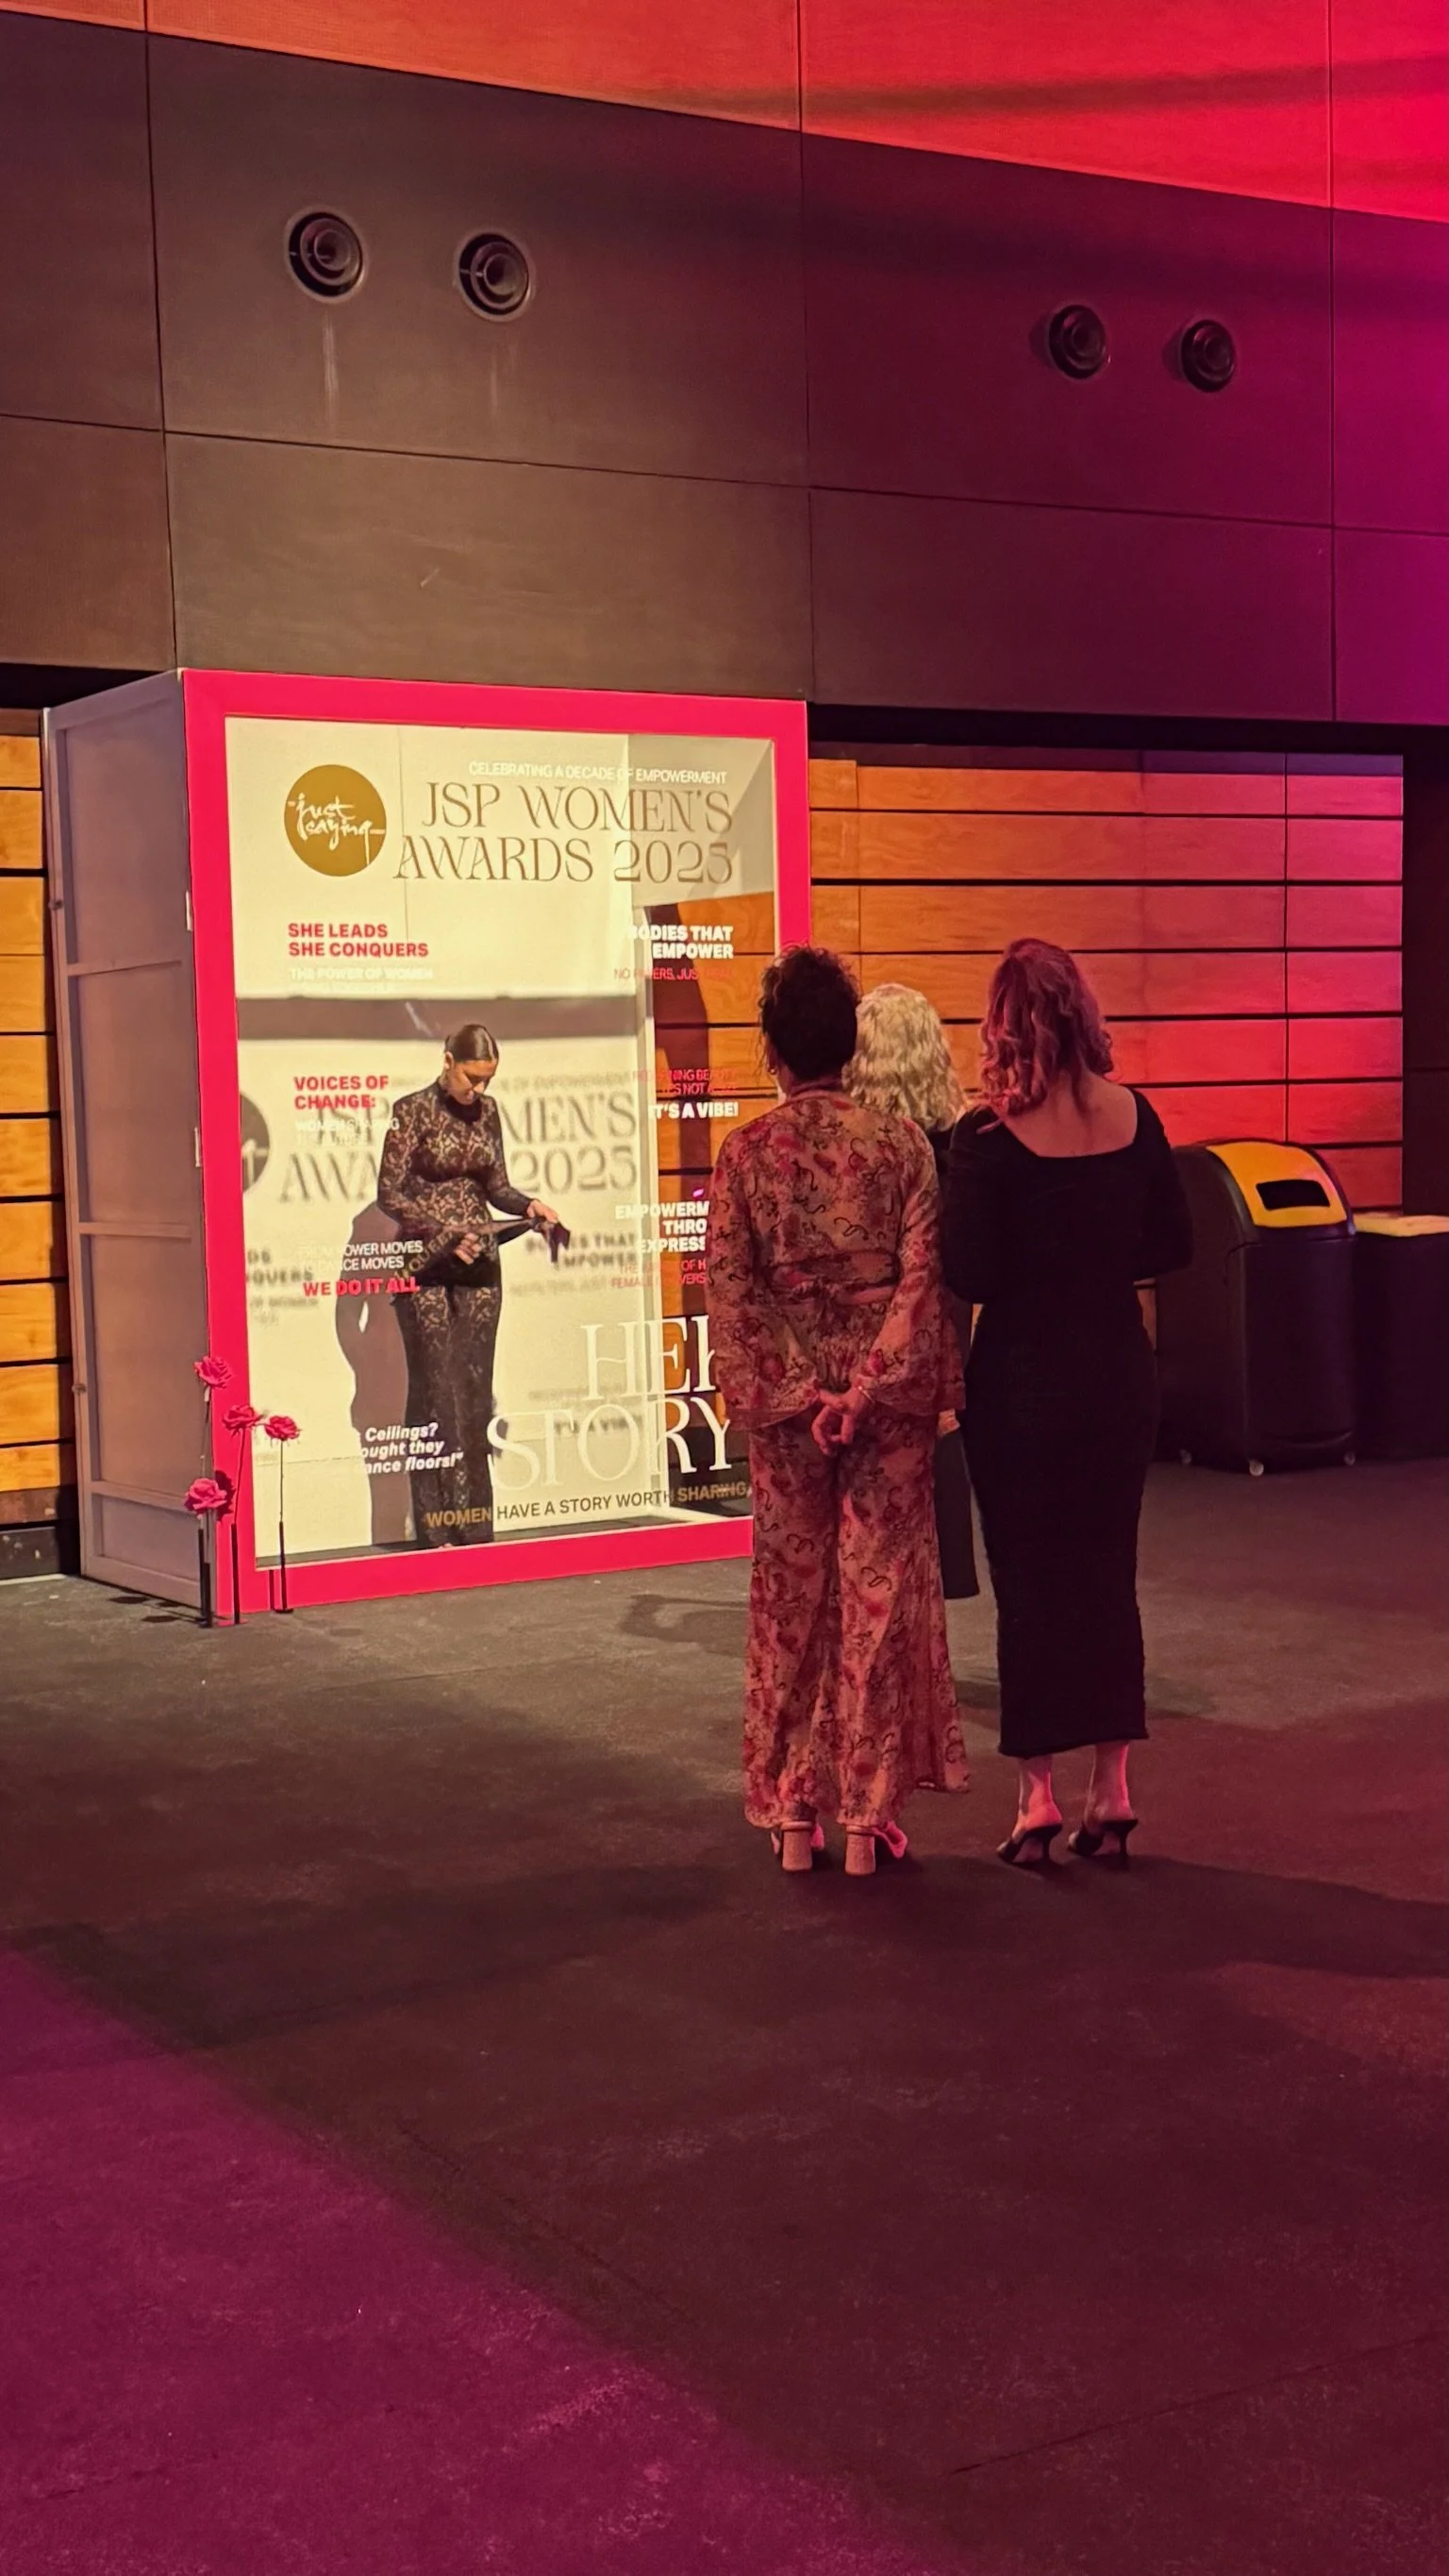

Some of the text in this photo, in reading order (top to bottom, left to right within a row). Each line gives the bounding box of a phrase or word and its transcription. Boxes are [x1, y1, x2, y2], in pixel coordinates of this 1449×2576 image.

[469, 761, 553, 778] CELEBRATING
[555, 766, 564, 778] A
[566, 767, 613, 780] DECADE
[636, 769, 728, 785] EMPOWERMENT
[422, 782, 733, 833] JSP WOMEN'S
[392, 836, 733, 883] AWARDS 2025
[288, 923, 389, 938] SHE LEADS
[690, 925, 734, 941] THAT
[288, 942, 429, 958] SHE CONQUERS
[653, 943, 734, 959] EMPOWER
[676, 968, 700, 980] JUS
[293, 1075, 360, 1091] VOICES
[366, 1075, 389, 1090] OF
[683, 1082, 706, 1095] NOT
[294, 1094, 375, 1110] CHANGE:
[681, 1103, 695, 1119] A
[697, 1101, 739, 1118] VIBE!
[615, 1200, 709, 1219] EMPOWERM
[662, 1218, 708, 1235] THRO
[341, 1244, 378, 1257] OWER
[381, 1240, 424, 1255] MOVES
[640, 1235, 707, 1254] EXPRES
[361, 1256, 404, 1270] MOVES
[303, 1276, 420, 1297] WE DO IT ALL
[365, 1422, 439, 1442] Ceilings?
[361, 1439, 444, 1460] ought they
[487, 1397, 732, 1491] STORY
[364, 1461, 402, 1474] ance
[425, 1507, 491, 1528] WOMEN
[497, 1502, 541, 1520] HAVE
[544, 1500, 559, 1516] A
[559, 1495, 612, 1514] STORY
[616, 1489, 674, 1508] WORTH
